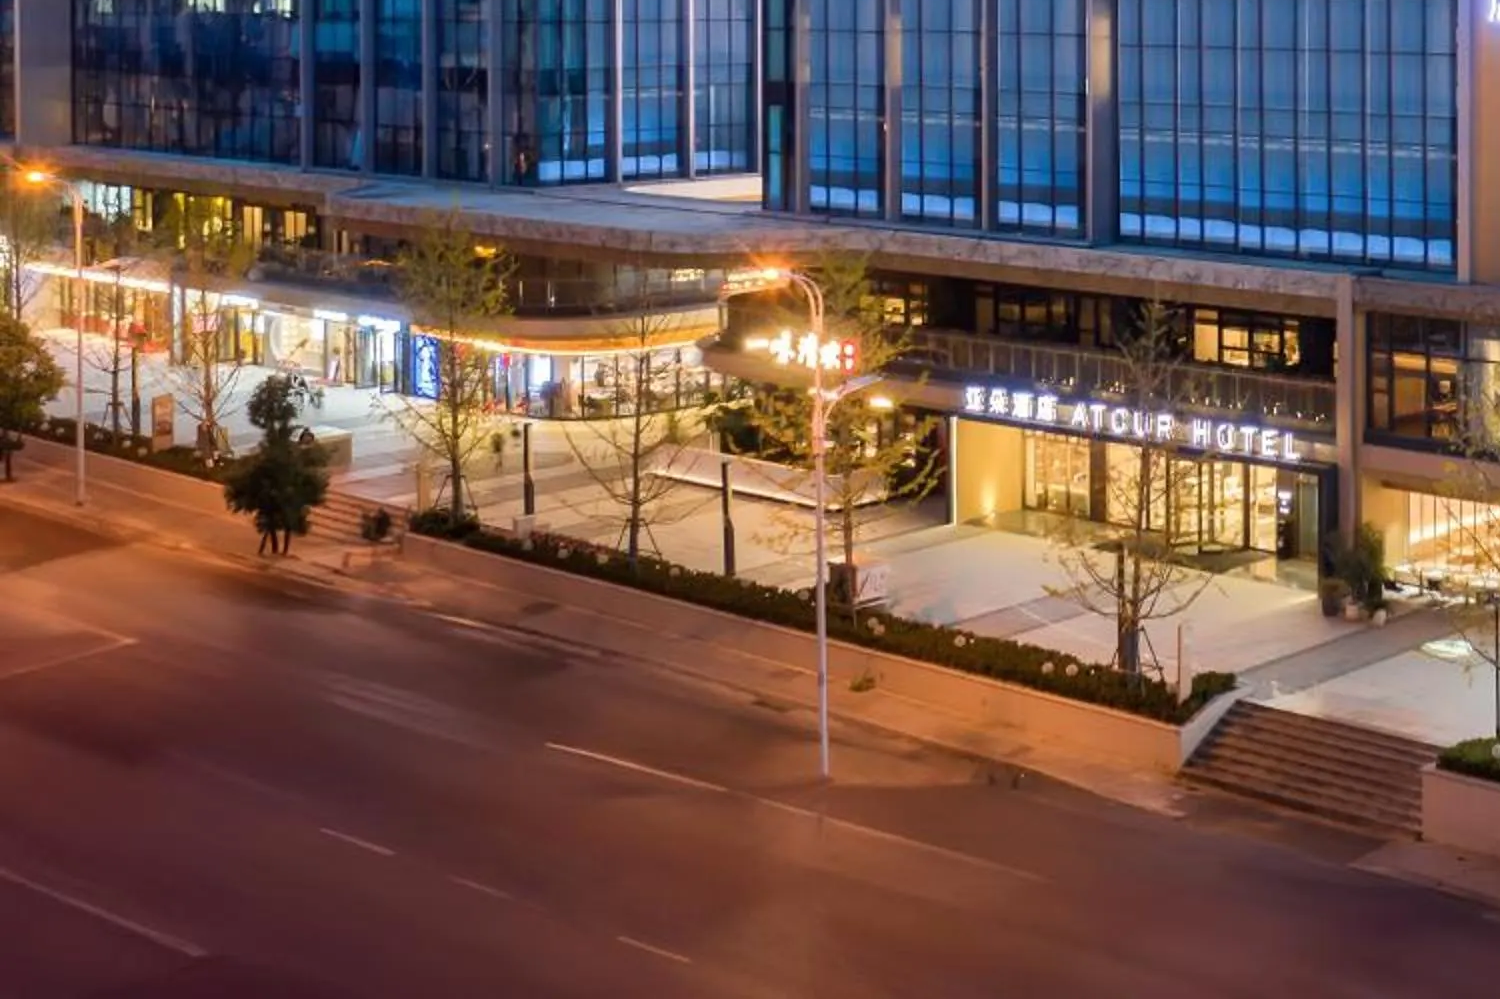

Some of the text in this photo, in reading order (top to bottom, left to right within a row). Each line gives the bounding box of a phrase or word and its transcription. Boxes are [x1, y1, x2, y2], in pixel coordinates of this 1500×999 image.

[965, 386, 1059, 422] 亚朵酒店
[1193, 418, 1301, 460] HOTEL
